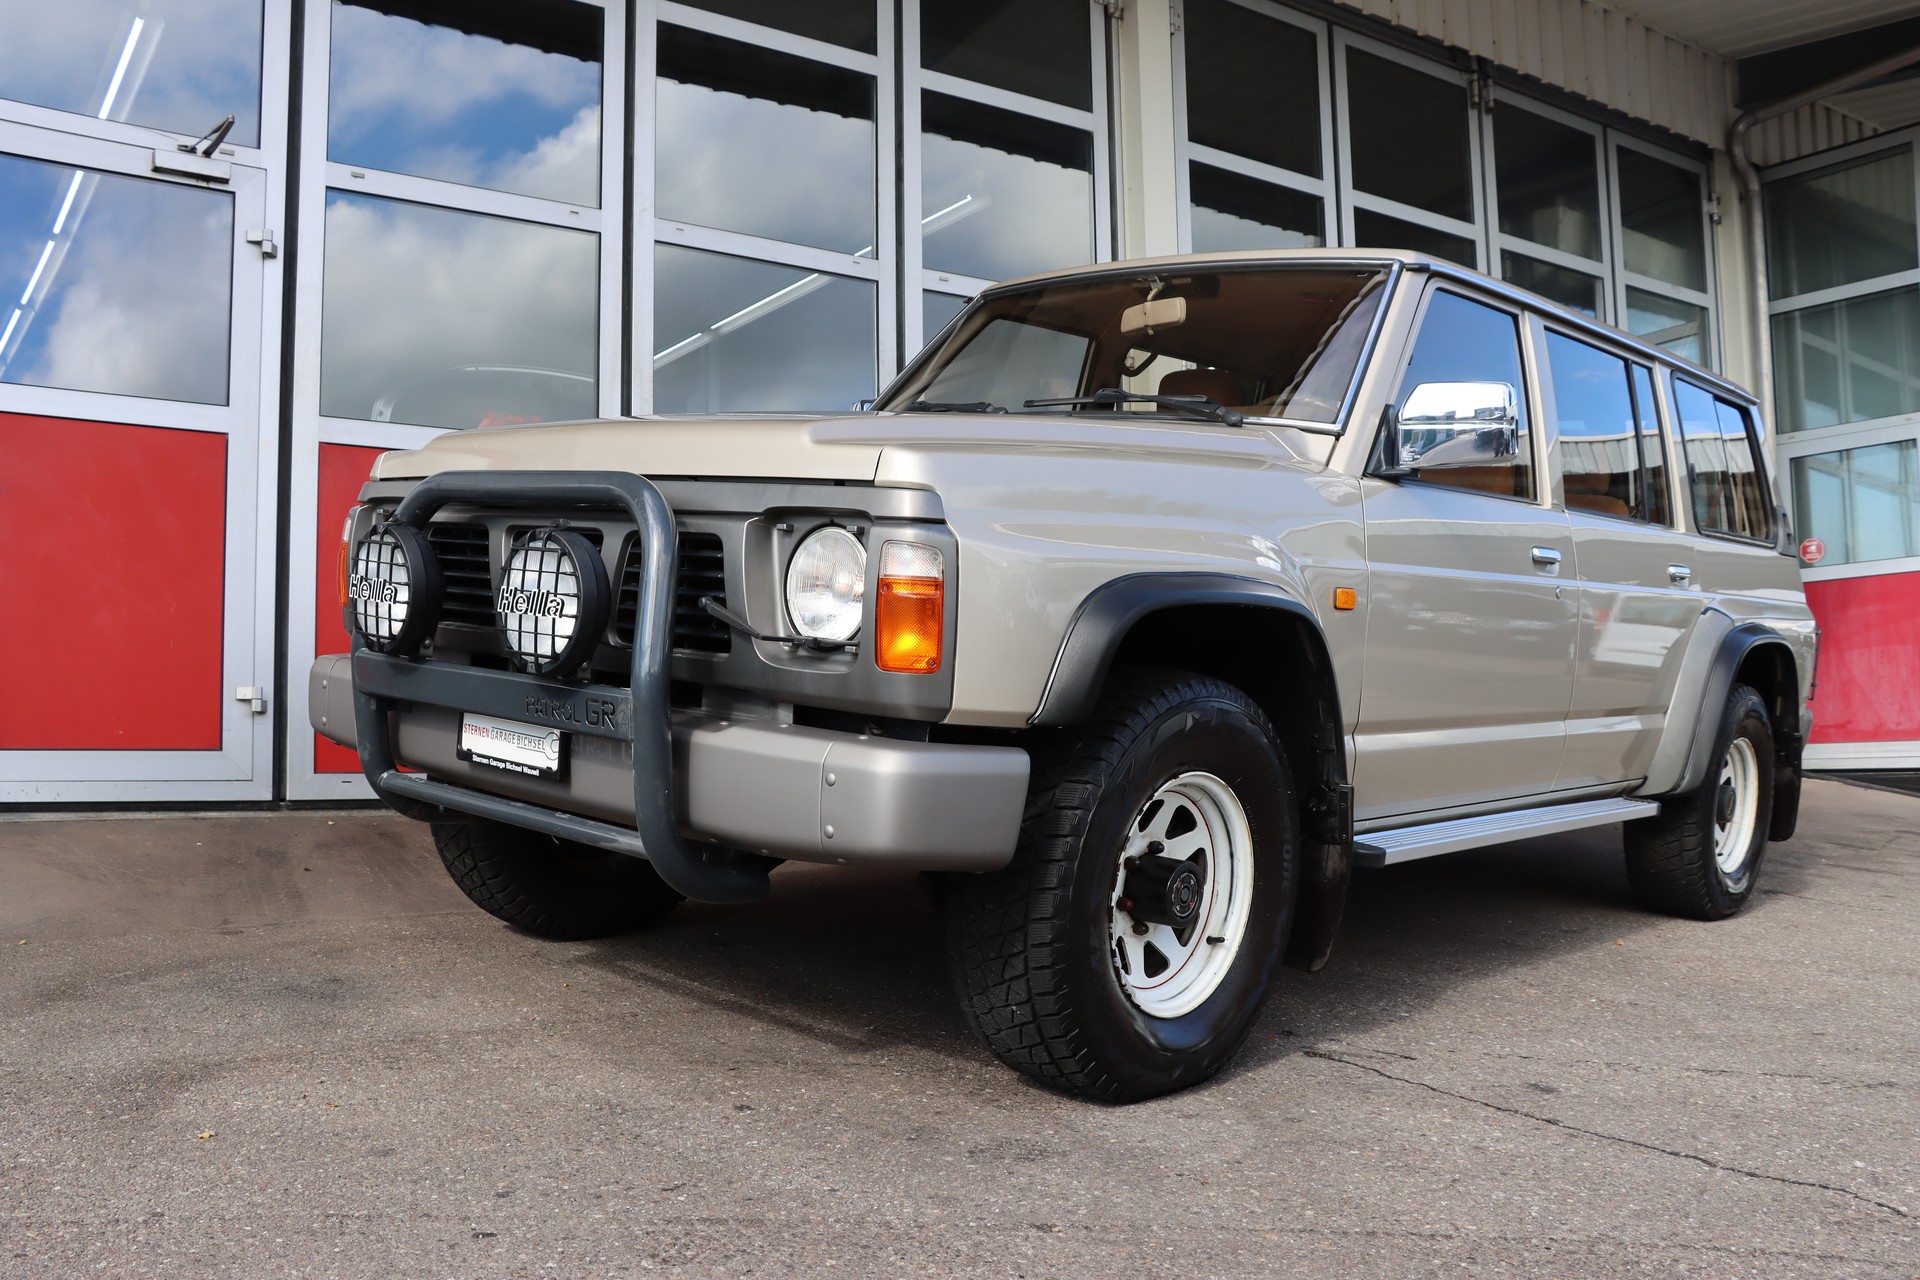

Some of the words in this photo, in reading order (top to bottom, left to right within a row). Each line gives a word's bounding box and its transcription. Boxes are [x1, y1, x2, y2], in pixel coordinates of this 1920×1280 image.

[348, 574, 398, 604] Hella
[497, 585, 565, 618] Hella
[525, 695, 581, 724] PATROL
[585, 698, 616, 731] GR
[463, 723, 490, 738] STERNEN
[490, 729, 516, 744] GARAGE
[516, 735, 546, 750] BICHSEL
[472, 754, 489, 765] Sternen
[489, 758, 505, 769] Garage
[505, 762, 522, 773] Bichsel
